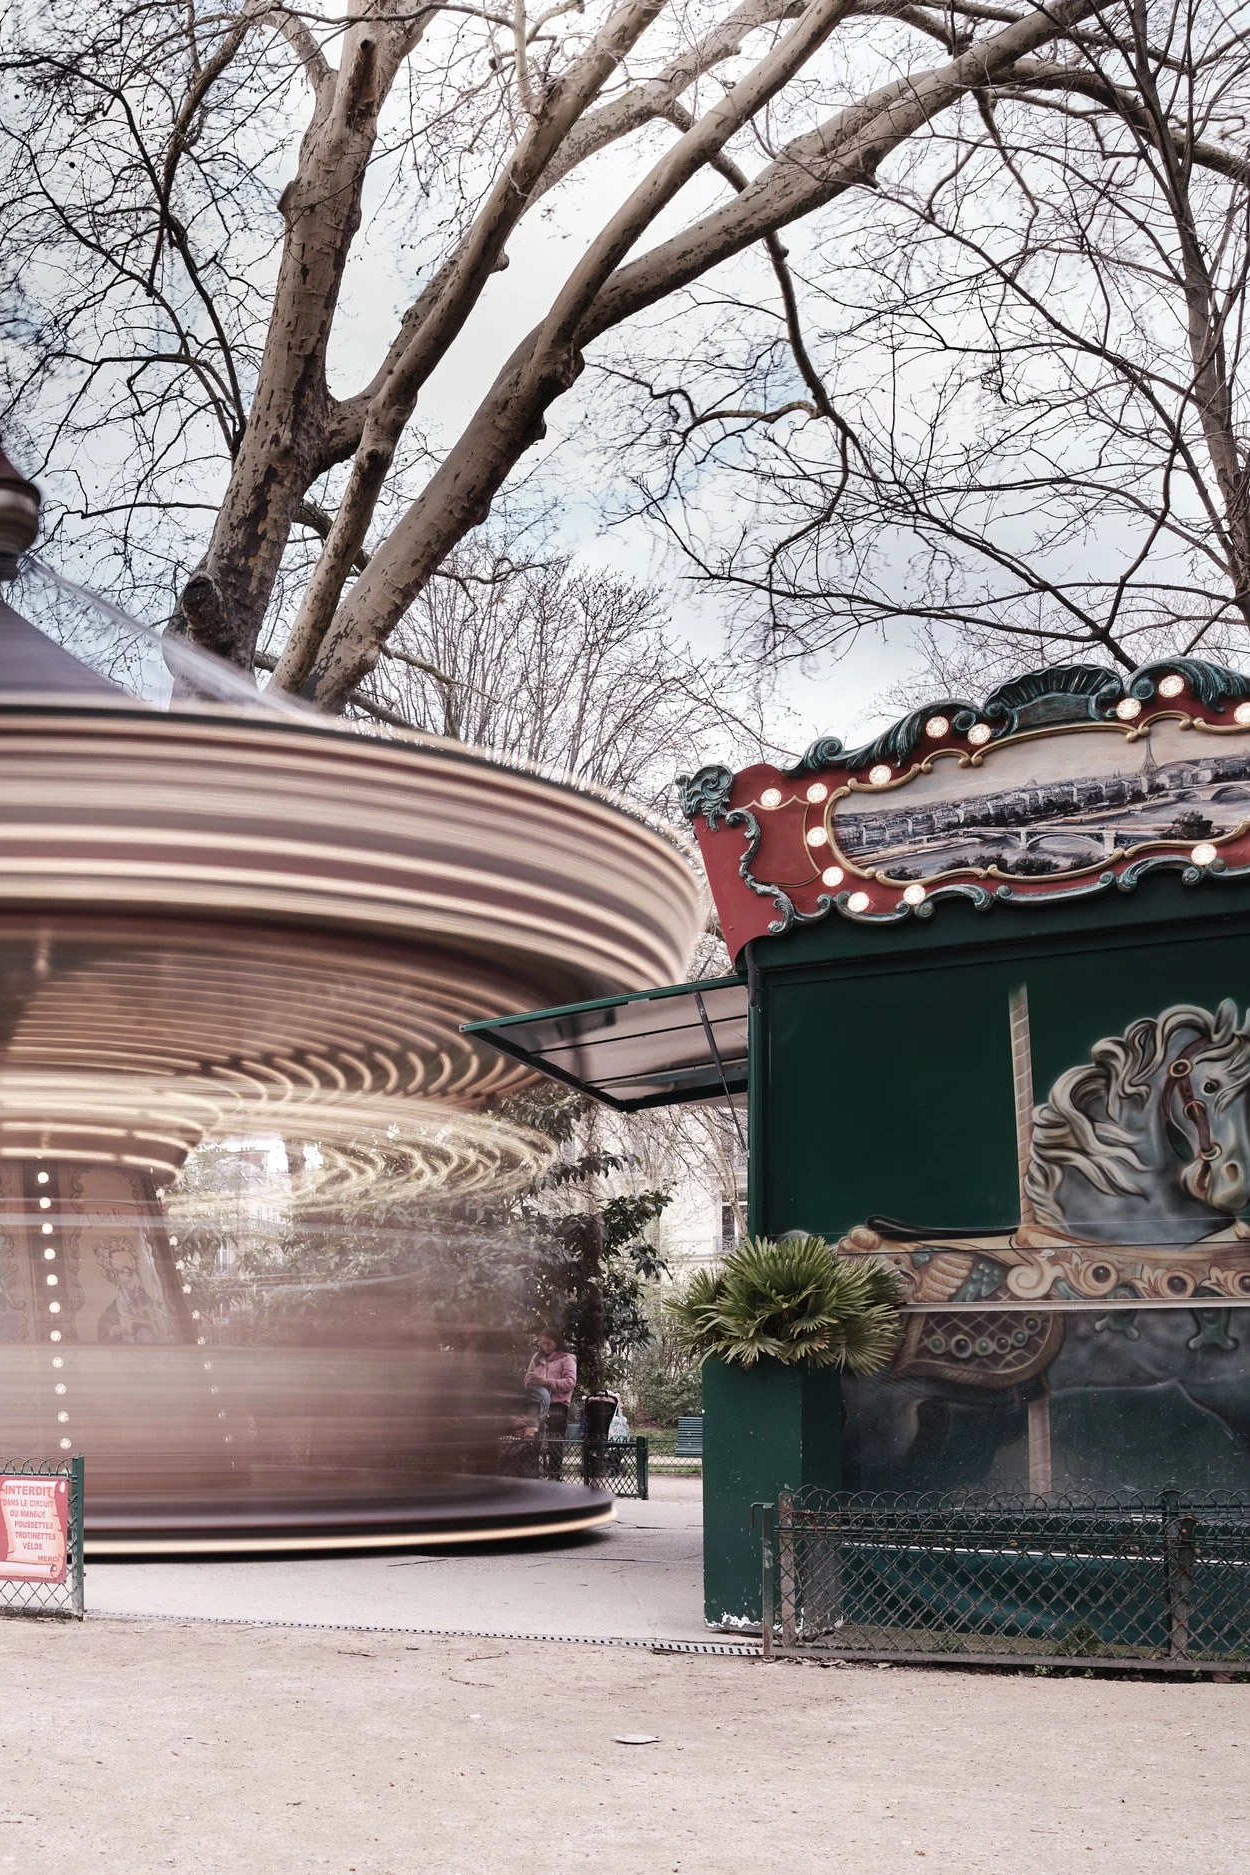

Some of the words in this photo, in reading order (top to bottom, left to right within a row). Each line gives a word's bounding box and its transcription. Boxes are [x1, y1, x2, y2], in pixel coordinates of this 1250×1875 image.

[5, 1485, 53, 1497] INTERDIT
[3, 1498, 19, 1507] DANS
[29, 1500, 55, 1508] CIRCUIT
[10, 1509, 19, 1518] DU
[14, 1520, 54, 1530] POUSSETTES
[15, 1531, 57, 1541] TROTINETTES
[38, 1555, 60, 1563] MERCI
